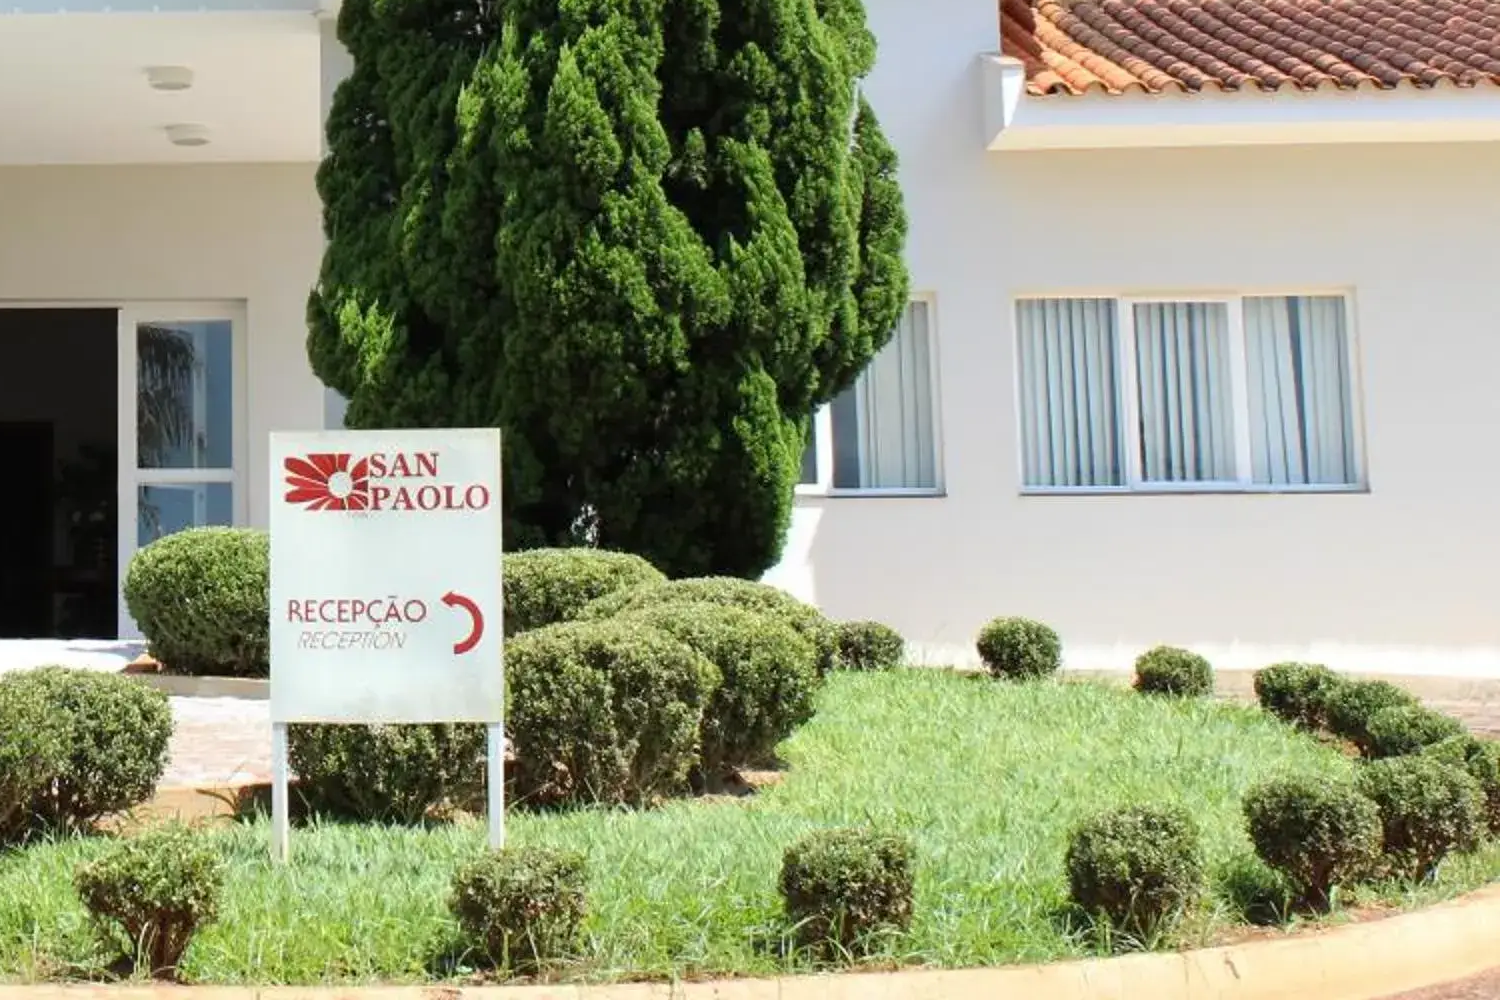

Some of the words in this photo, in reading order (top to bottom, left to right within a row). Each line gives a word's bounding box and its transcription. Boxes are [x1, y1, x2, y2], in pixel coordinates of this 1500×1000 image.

[369, 452, 439, 478] SAN
[370, 485, 490, 511] PAOLO
[287, 595, 427, 629] RECEPÇÃO
[297, 631, 407, 650] RECEPTION
